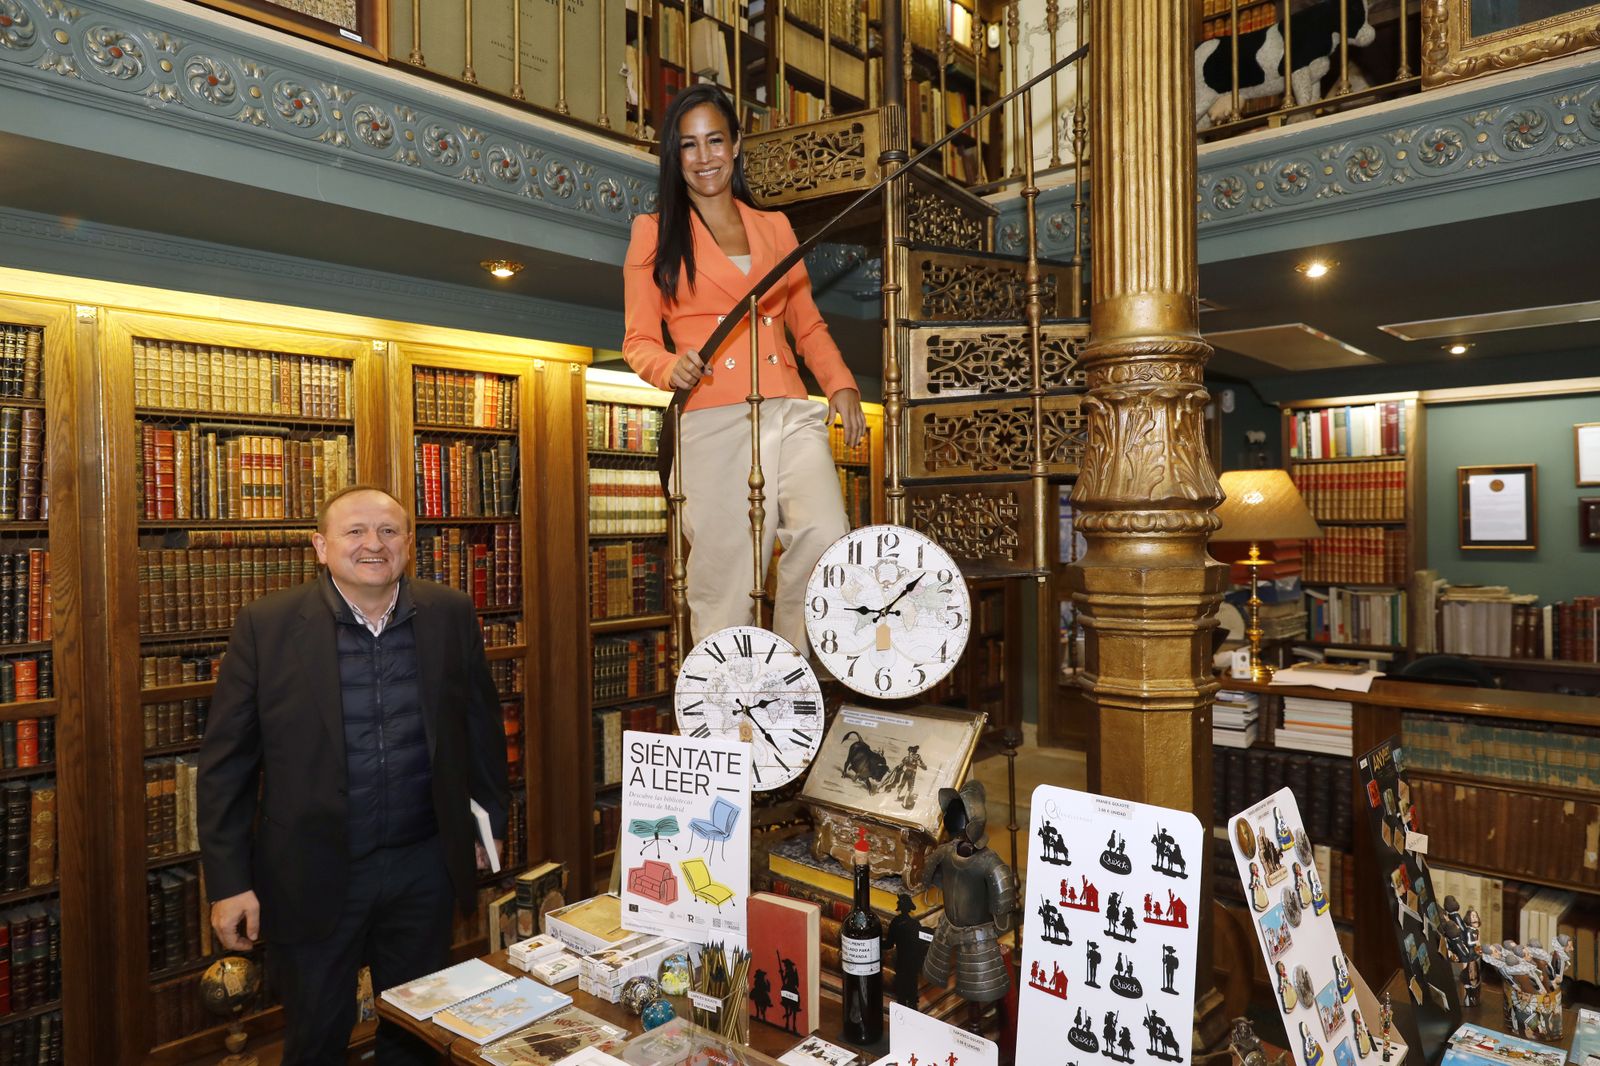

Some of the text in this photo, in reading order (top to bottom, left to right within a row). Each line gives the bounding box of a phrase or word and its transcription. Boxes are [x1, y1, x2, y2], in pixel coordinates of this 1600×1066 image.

[848, 541, 862, 565] 11
[876, 533, 900, 558] 12
[917, 544, 924, 568] 1
[823, 565, 846, 588] 10
[937, 569, 953, 594] 2
[811, 596, 829, 620] 9
[820, 629, 839, 654] 8
[931, 639, 950, 663] 4
[783, 667, 805, 686] II
[846, 655, 861, 677] 7
[874, 667, 892, 691] 6
[793, 700, 816, 714] III
[630, 739, 742, 775] SIÉNTATE
[629, 766, 709, 796] A LEER
[628, 791, 654, 801] Descubre
[664, 795, 693, 805] bibliotecas
[664, 804, 685, 813] Madrid
